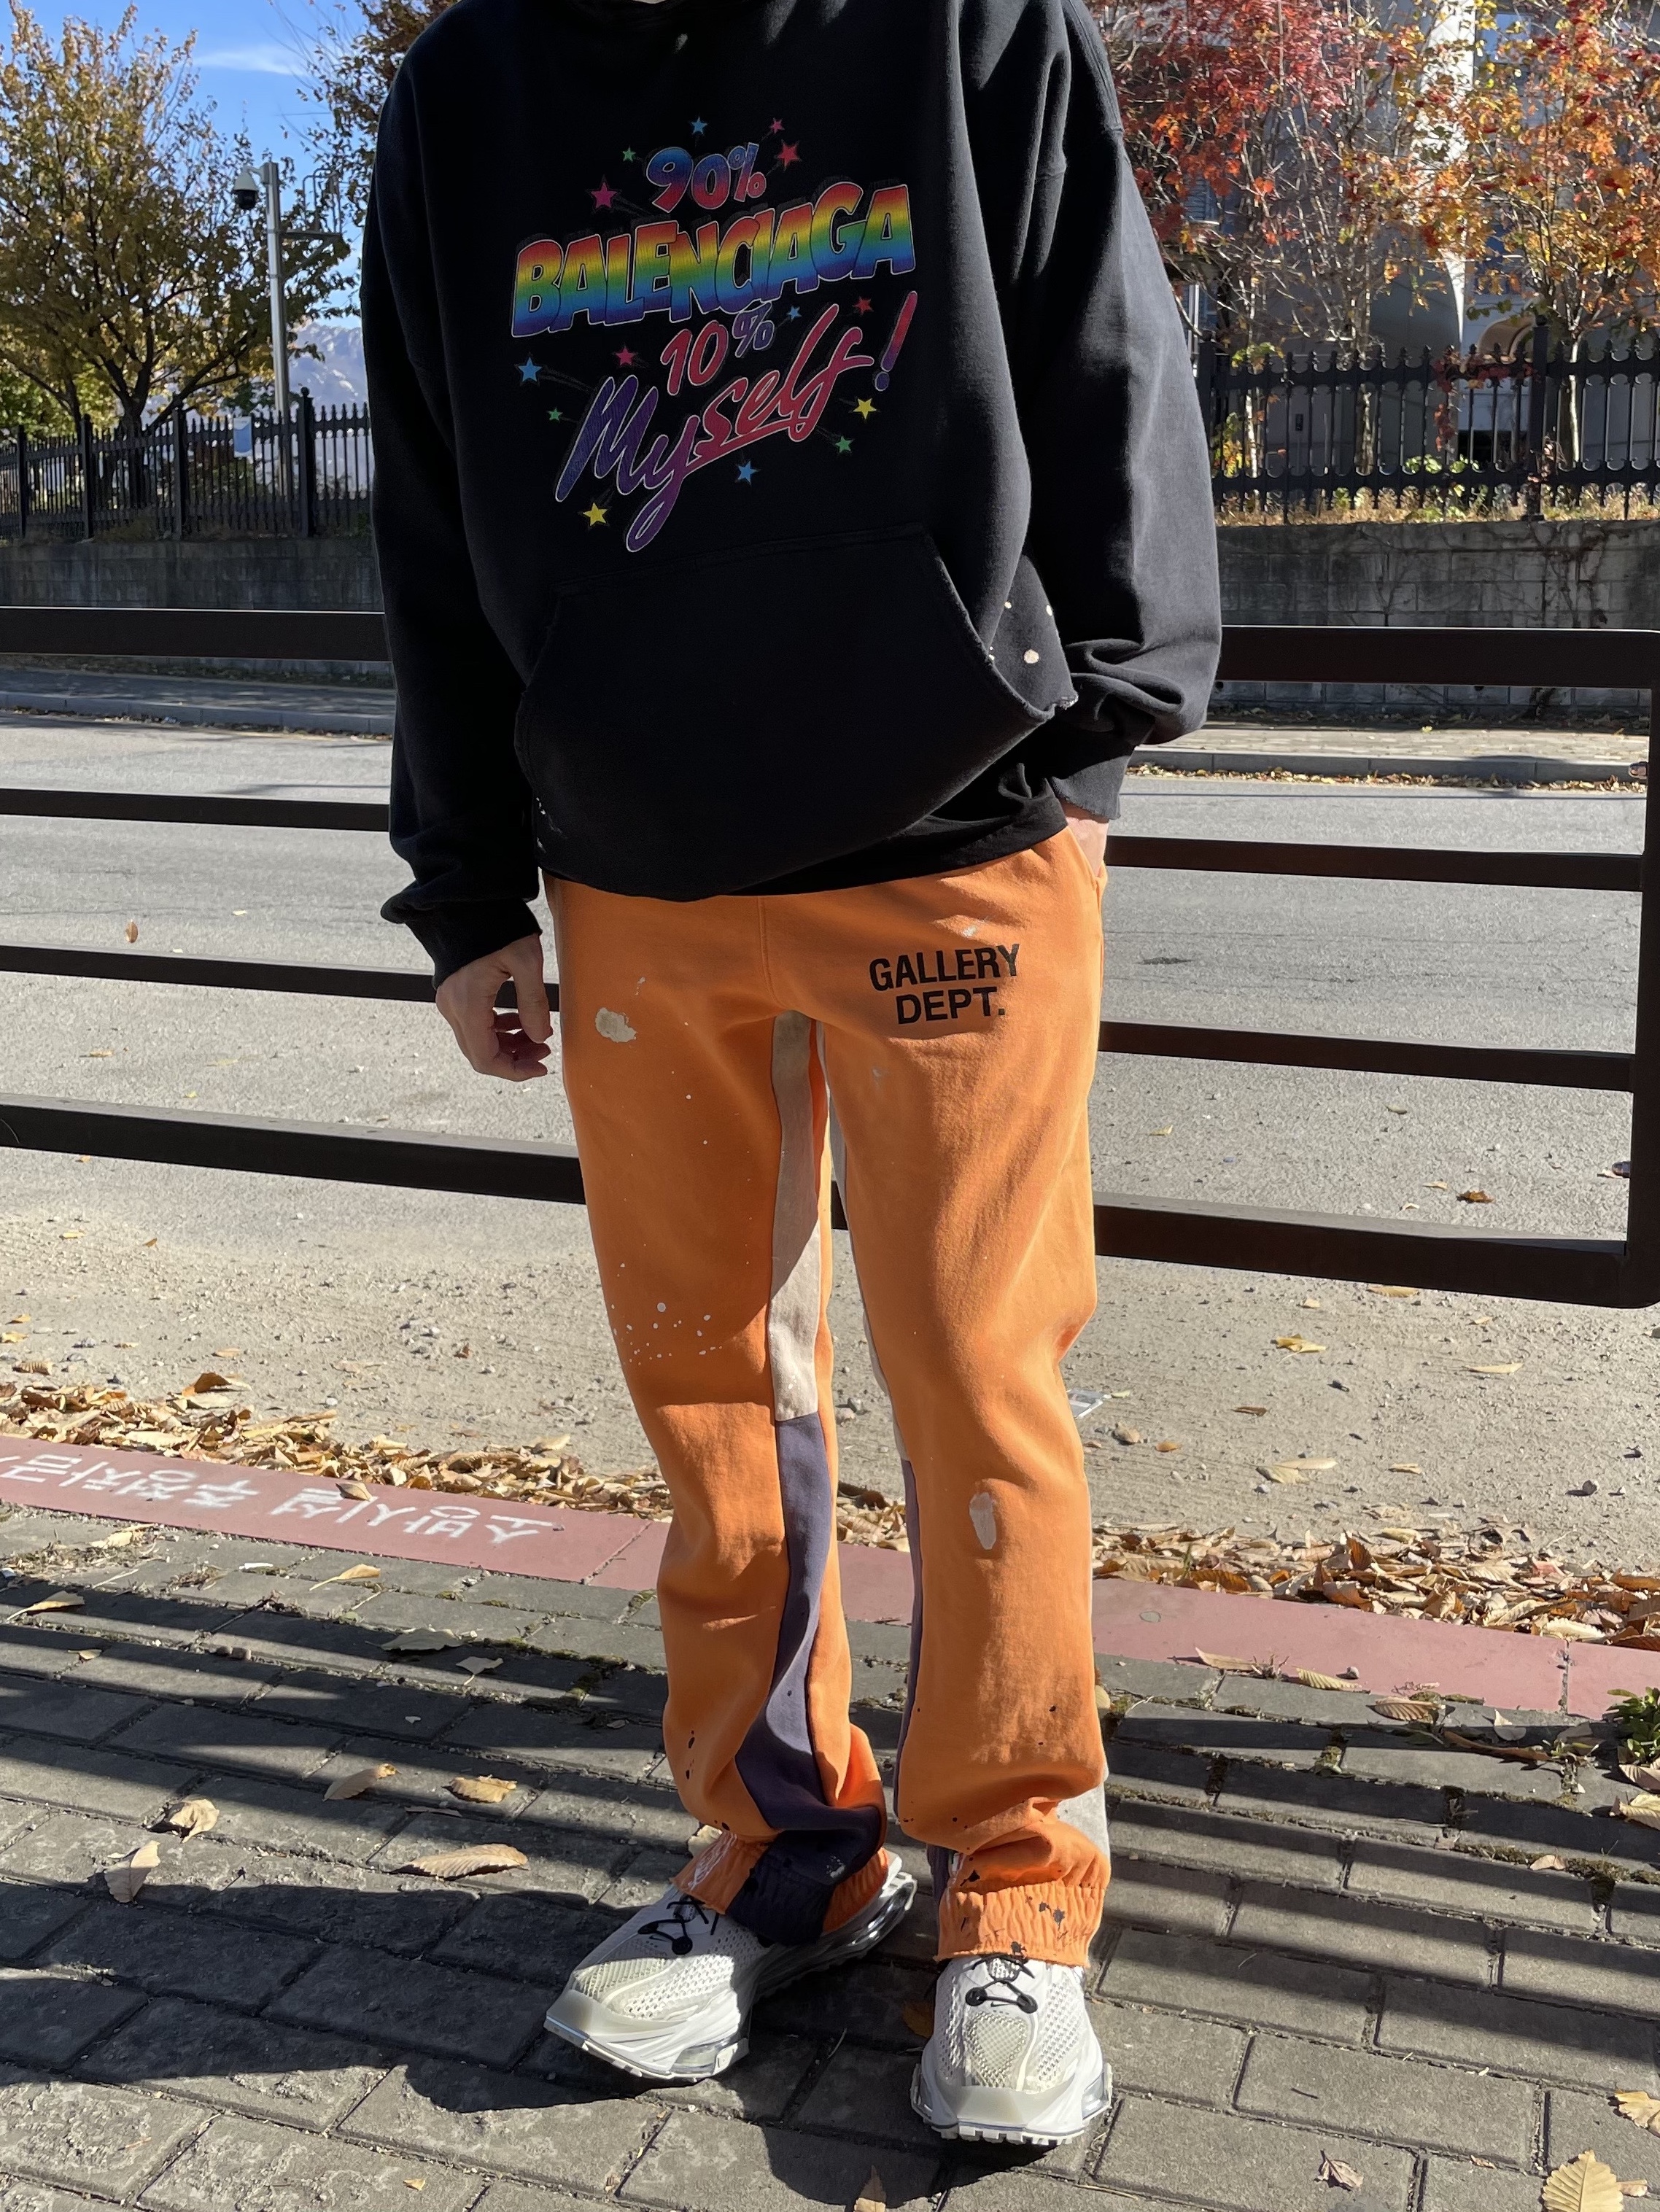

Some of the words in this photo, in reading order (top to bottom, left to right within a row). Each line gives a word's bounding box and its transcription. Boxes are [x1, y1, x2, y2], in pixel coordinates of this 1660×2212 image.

[646, 142, 767, 213] 90%
[511, 182, 916, 338] BALENCIAGA
[661, 300, 776, 396] 10%
[869, 944, 1020, 991] GALLERY
[896, 986, 1006, 1025] DEPT.
[0, 1454, 260, 1508] 주정차금
[271, 1488, 553, 1545] 소방시설
